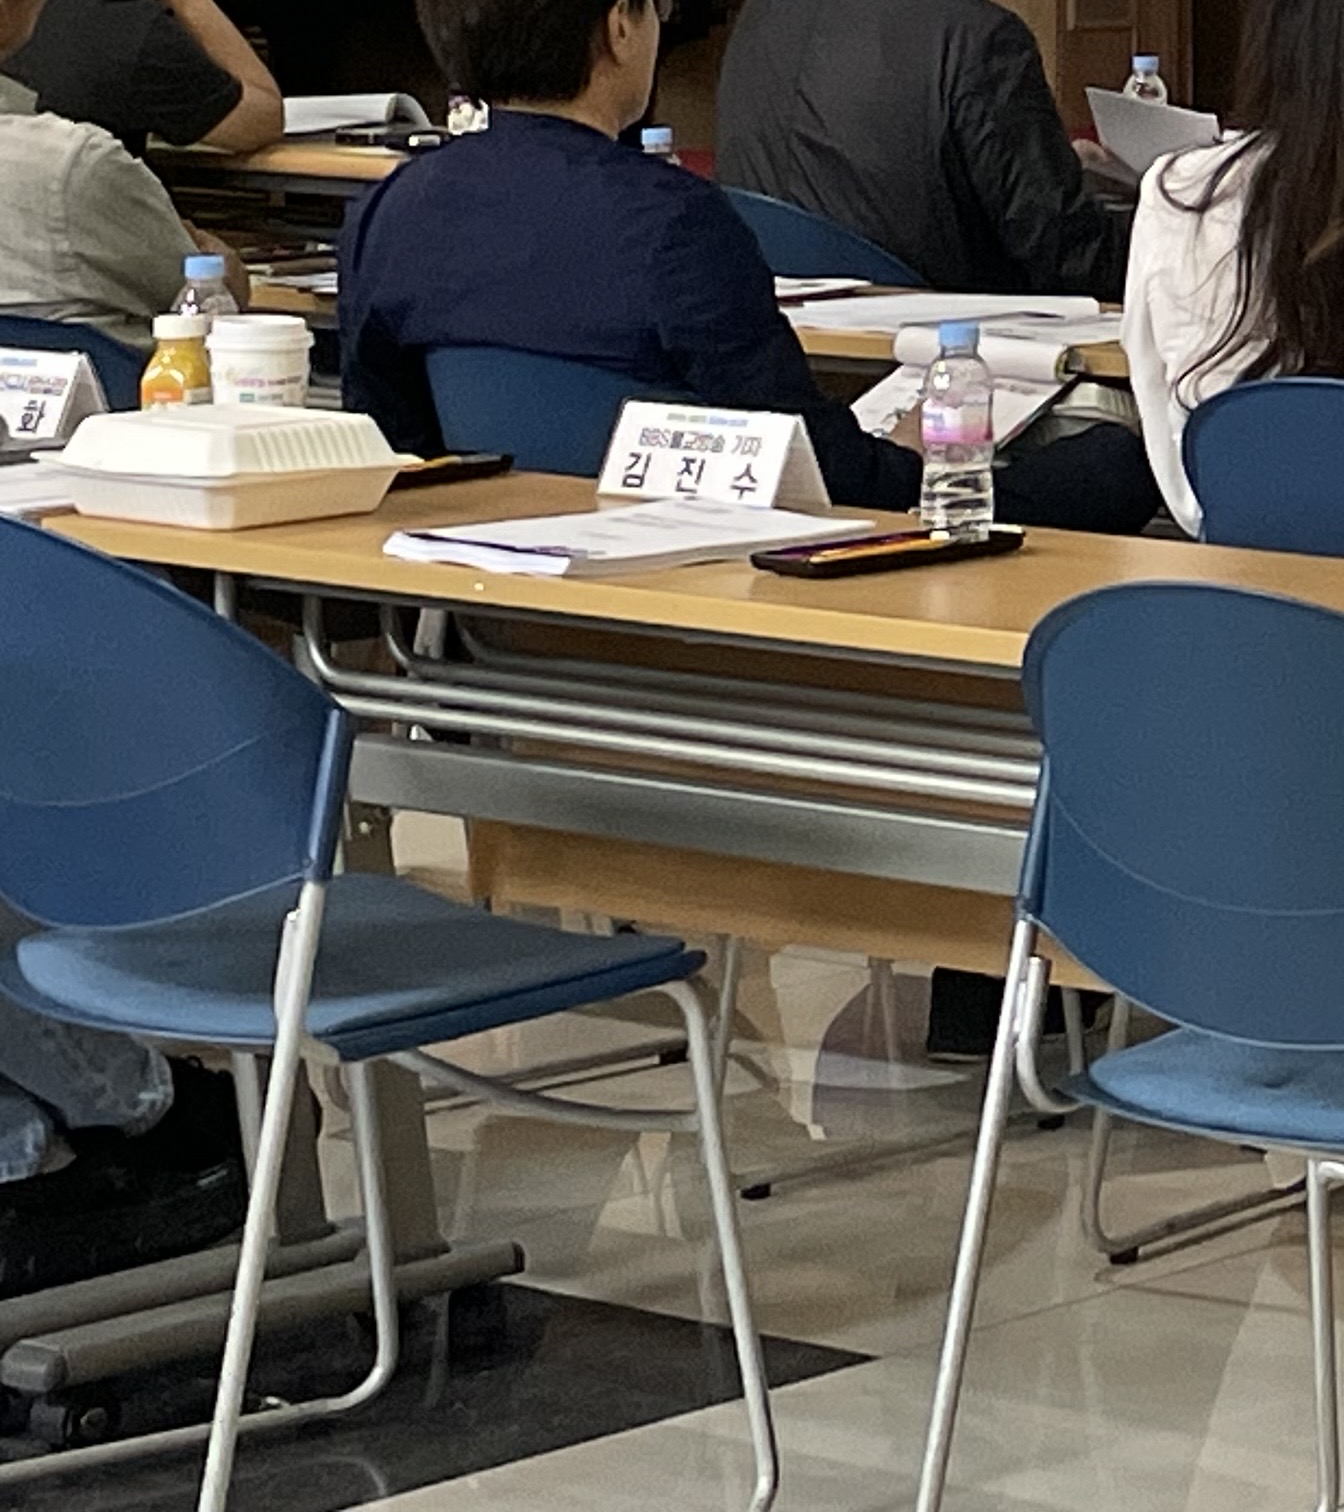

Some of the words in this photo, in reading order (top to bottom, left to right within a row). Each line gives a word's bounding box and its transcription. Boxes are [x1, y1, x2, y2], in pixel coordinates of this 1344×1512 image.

[620, 451, 652, 490] 김
[674, 455, 707, 496] 진
[729, 462, 759, 501] 수
